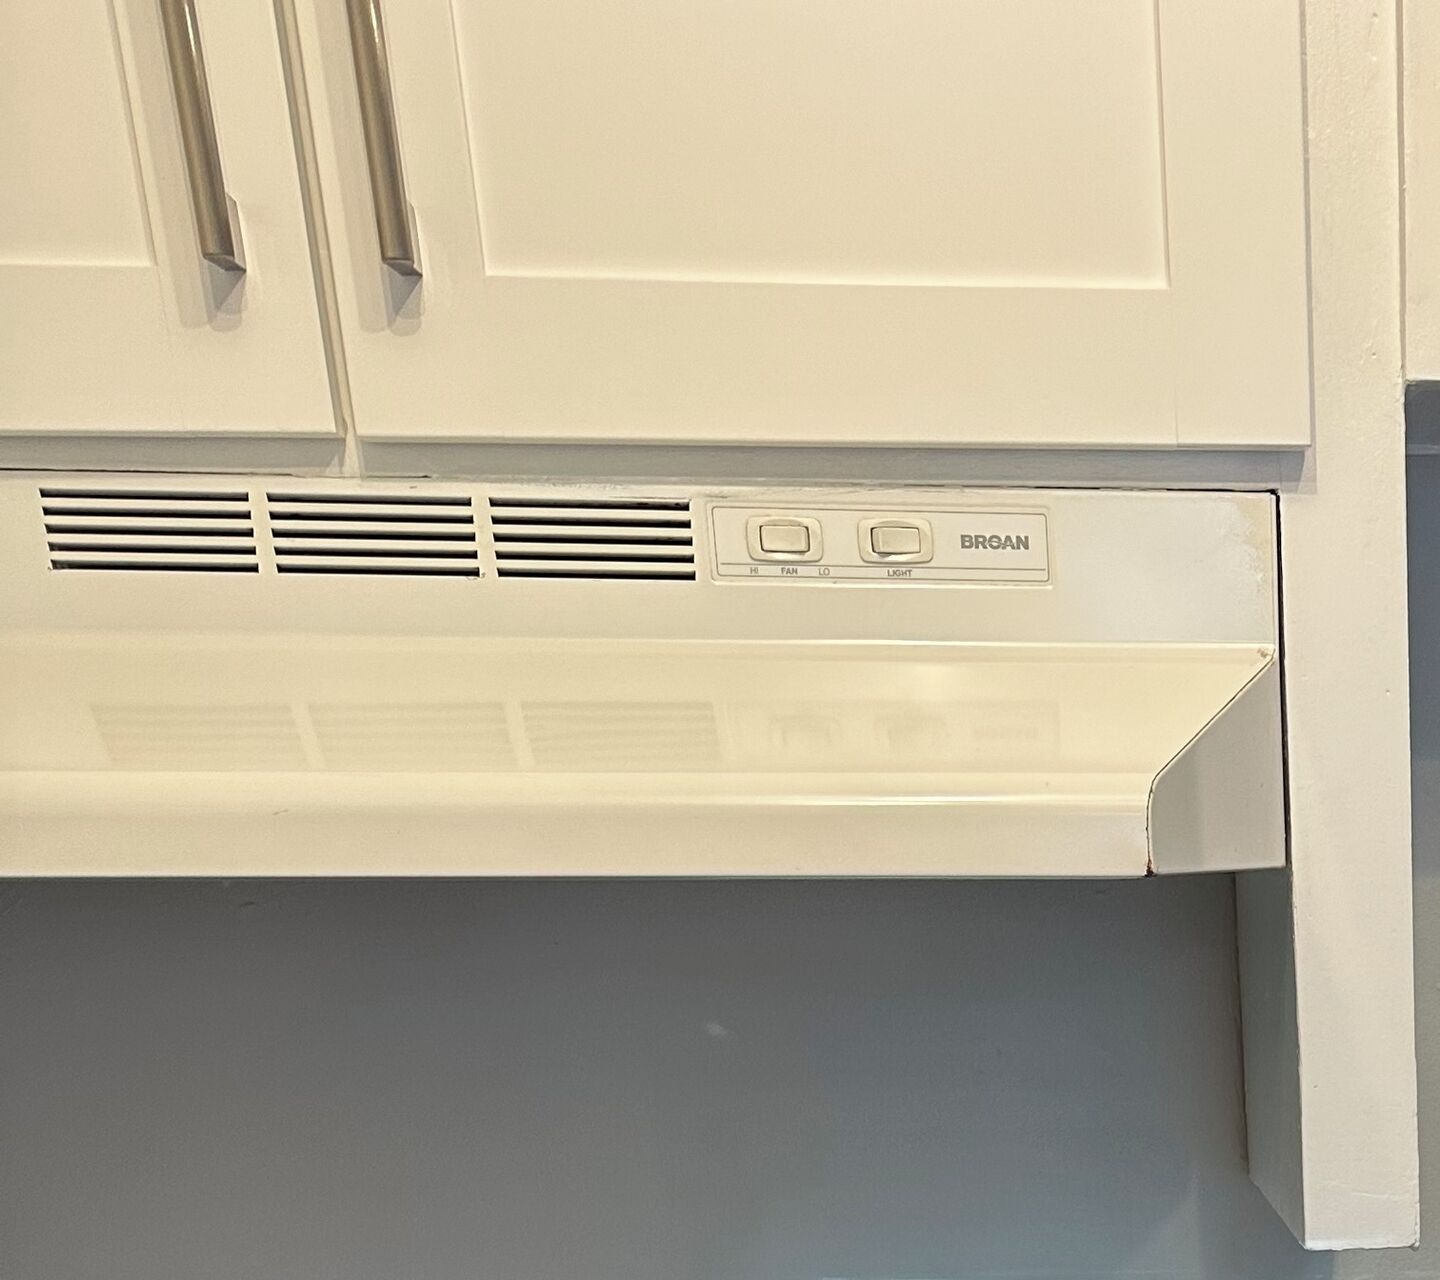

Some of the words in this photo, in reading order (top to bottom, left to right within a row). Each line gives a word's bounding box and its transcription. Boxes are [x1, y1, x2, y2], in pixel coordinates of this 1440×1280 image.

[960, 534, 1030, 550] BROAN
[781, 567, 798, 575] FAN
[818, 568, 831, 576] LO
[887, 569, 913, 577] LIGHT
